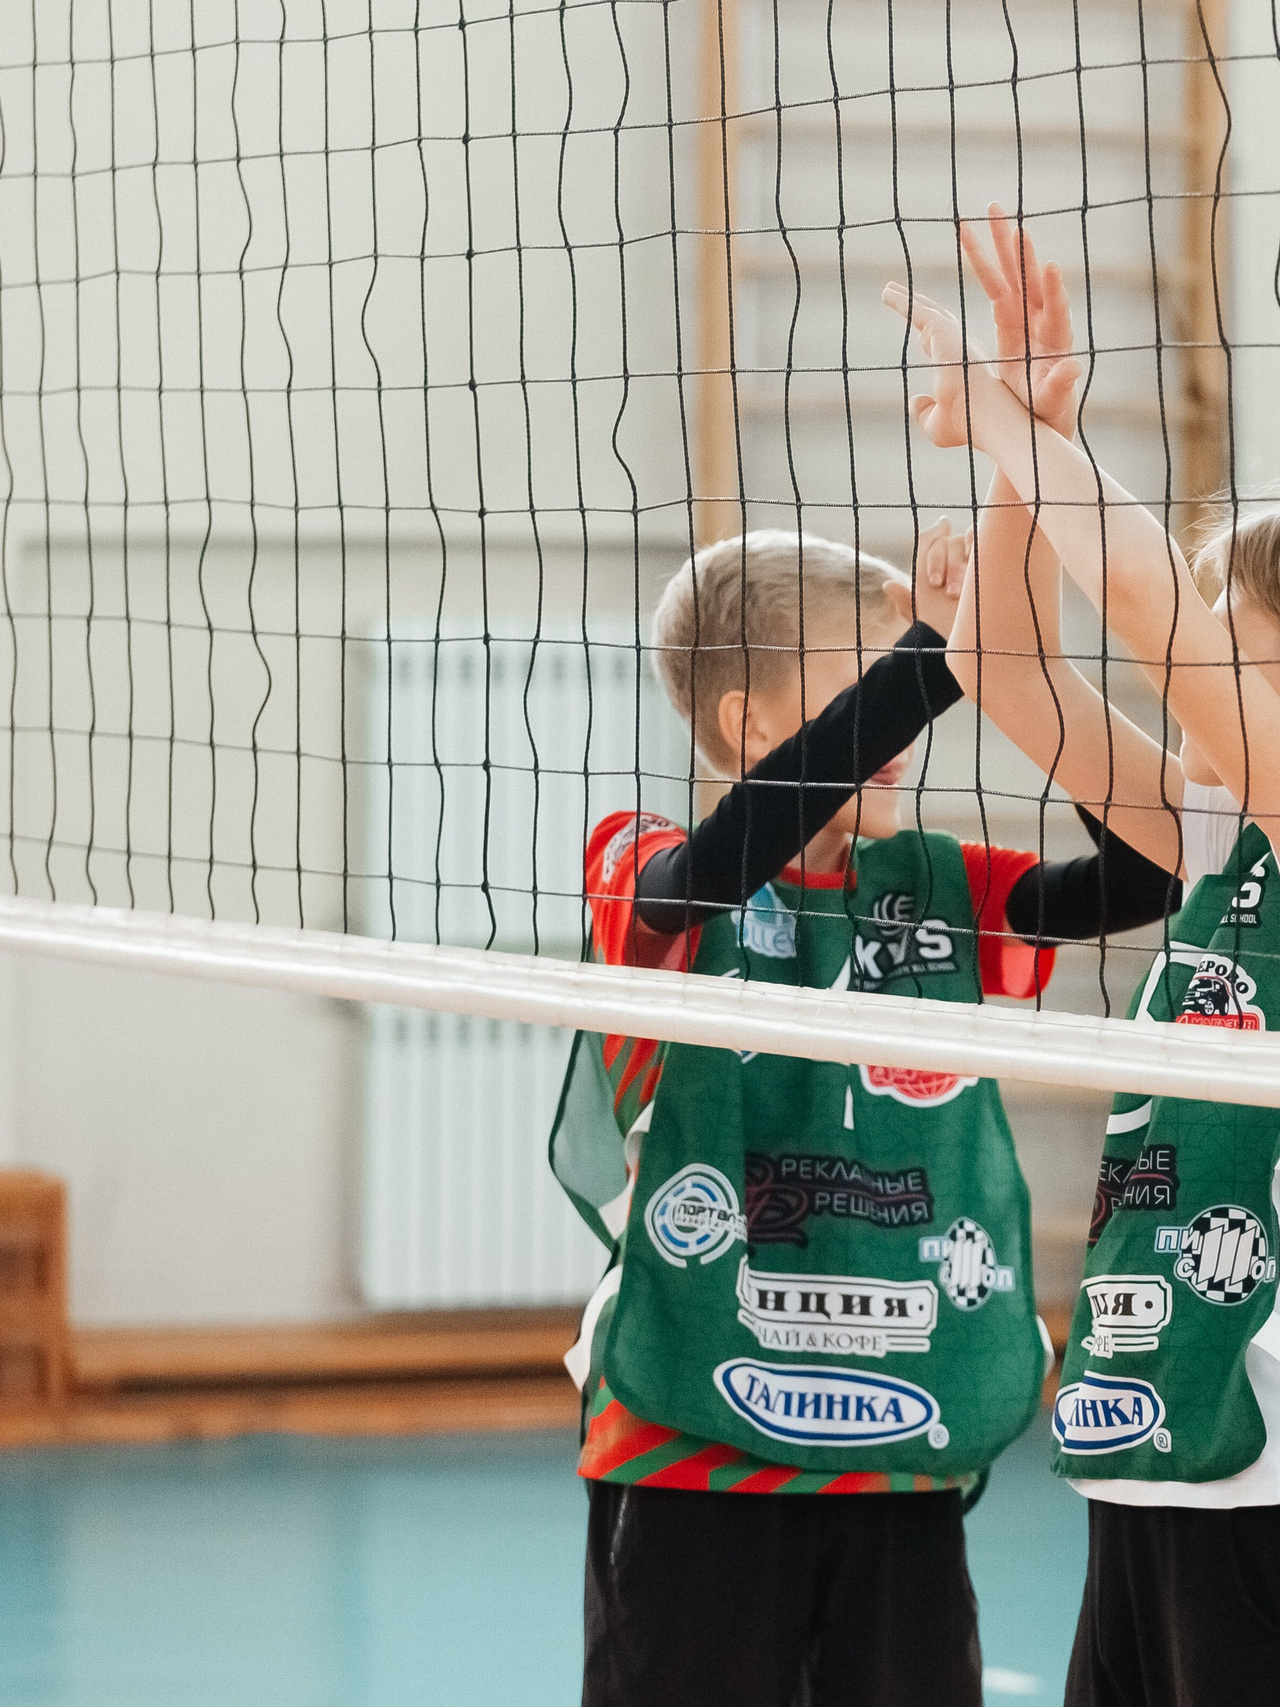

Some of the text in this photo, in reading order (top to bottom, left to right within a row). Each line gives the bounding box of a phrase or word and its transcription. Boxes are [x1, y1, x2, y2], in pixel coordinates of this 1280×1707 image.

[855, 918, 953, 979] KVS
[823, 1333, 883, 1351] КОФЕ
[745, 1375, 905, 1423] ТАЛИНКА
